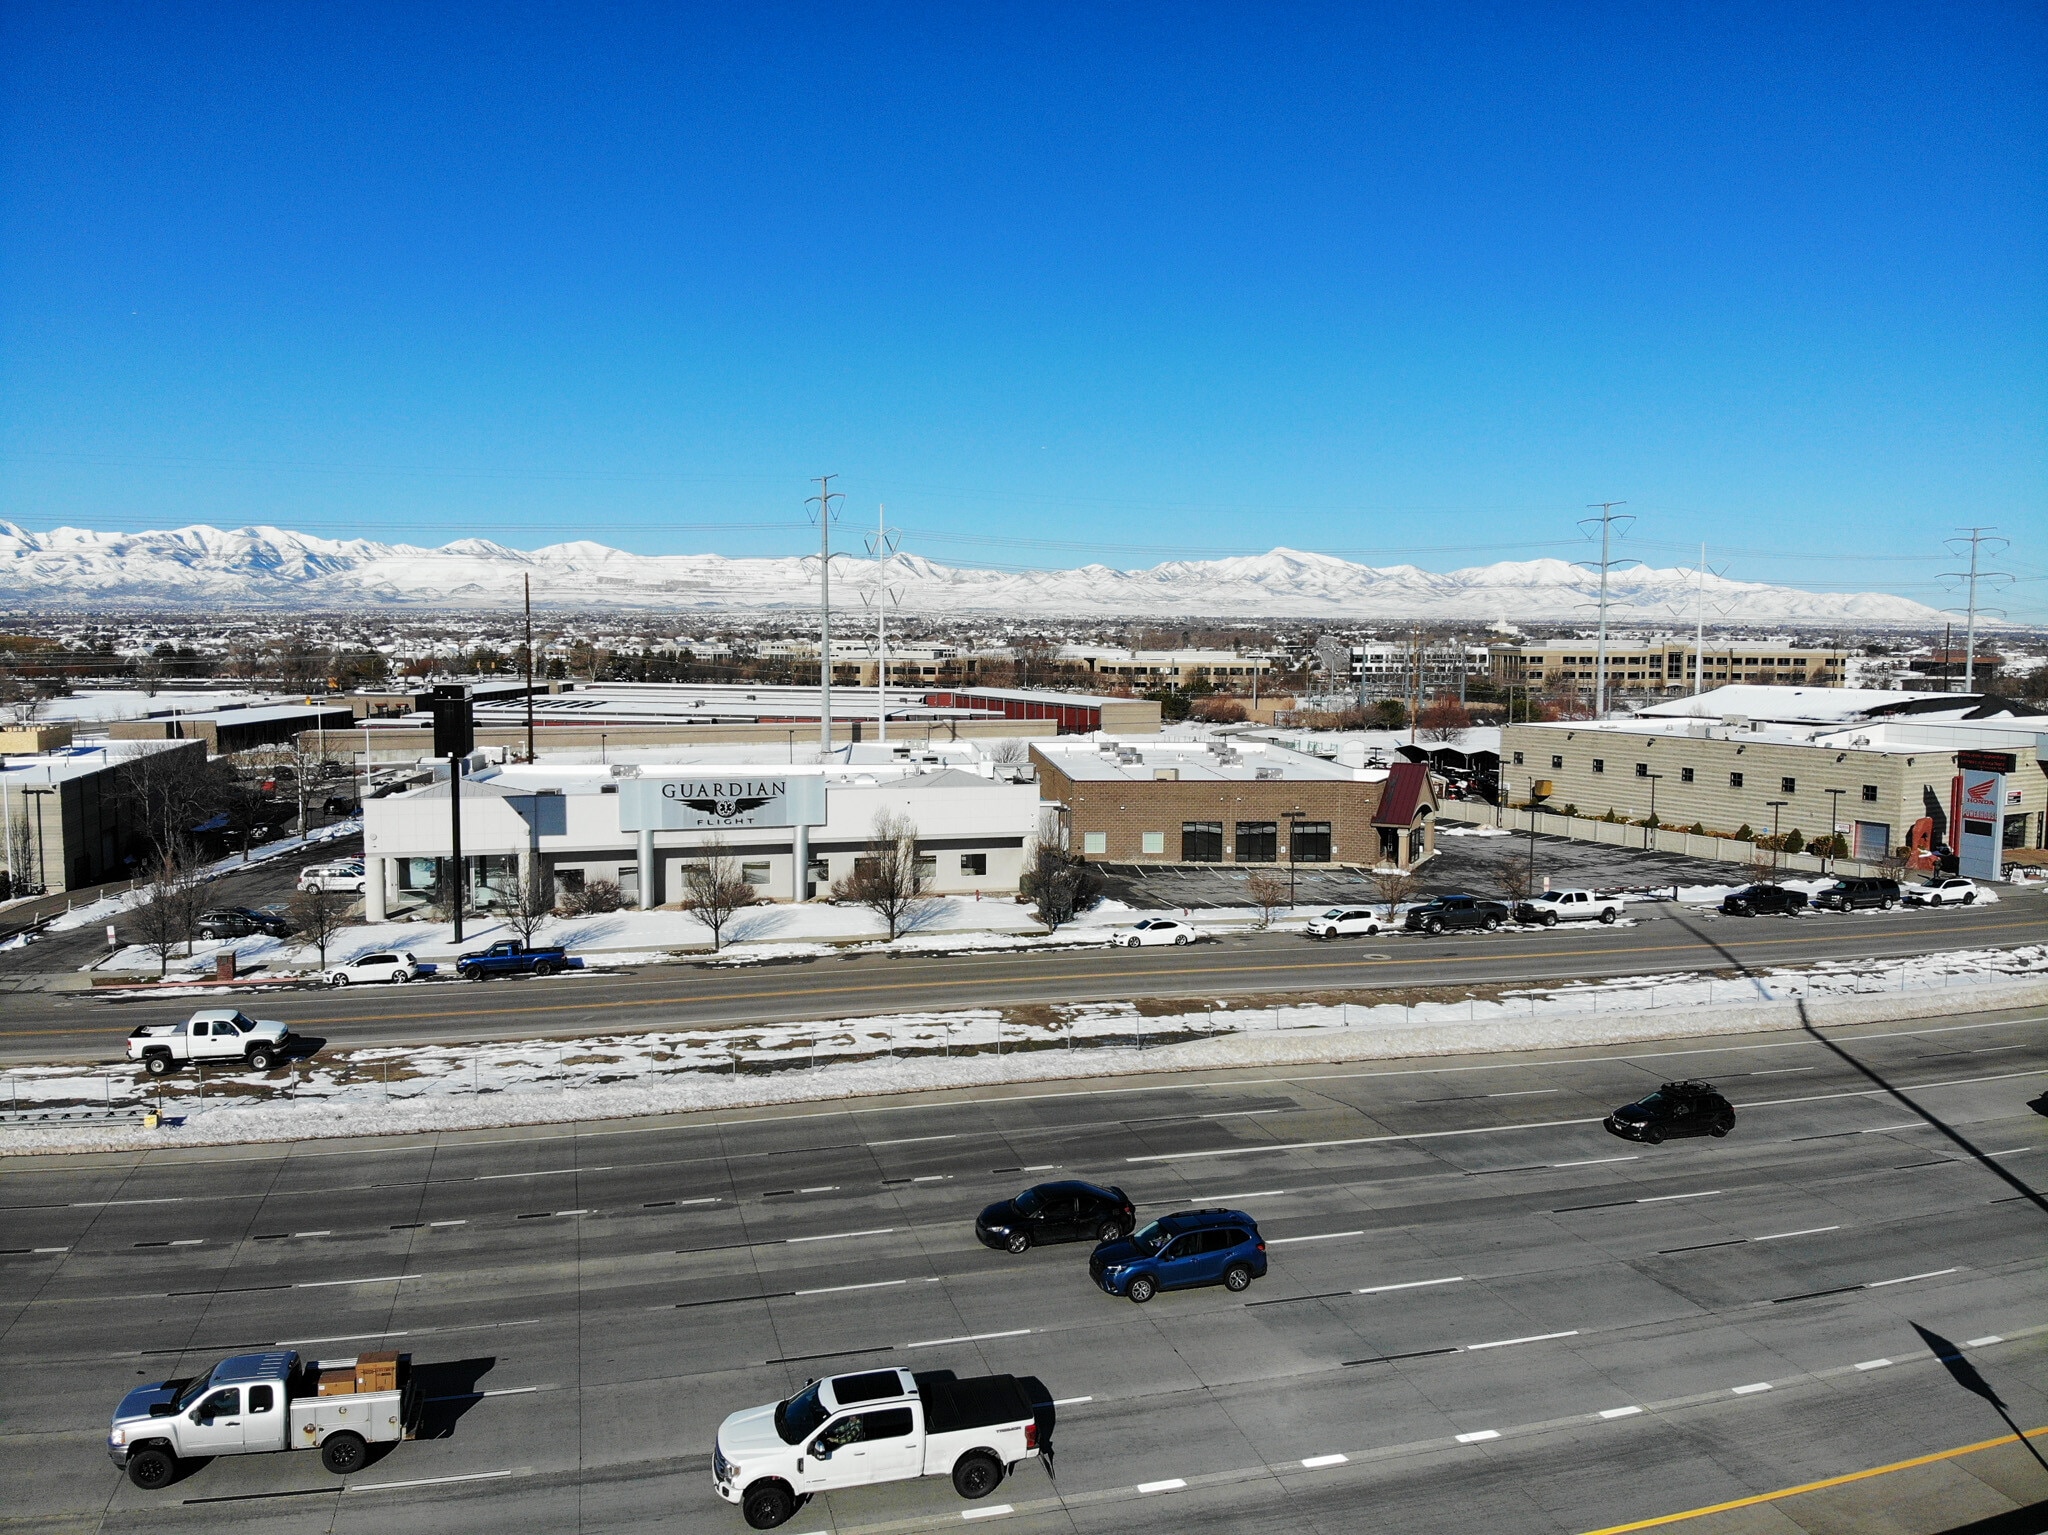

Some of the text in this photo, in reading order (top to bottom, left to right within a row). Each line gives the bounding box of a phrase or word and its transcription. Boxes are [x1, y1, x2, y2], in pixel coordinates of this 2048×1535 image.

[662, 781, 785, 798] GUARDIAN
[1966, 798, 1995, 806] HONDA
[697, 818, 756, 826] FLIGHT
